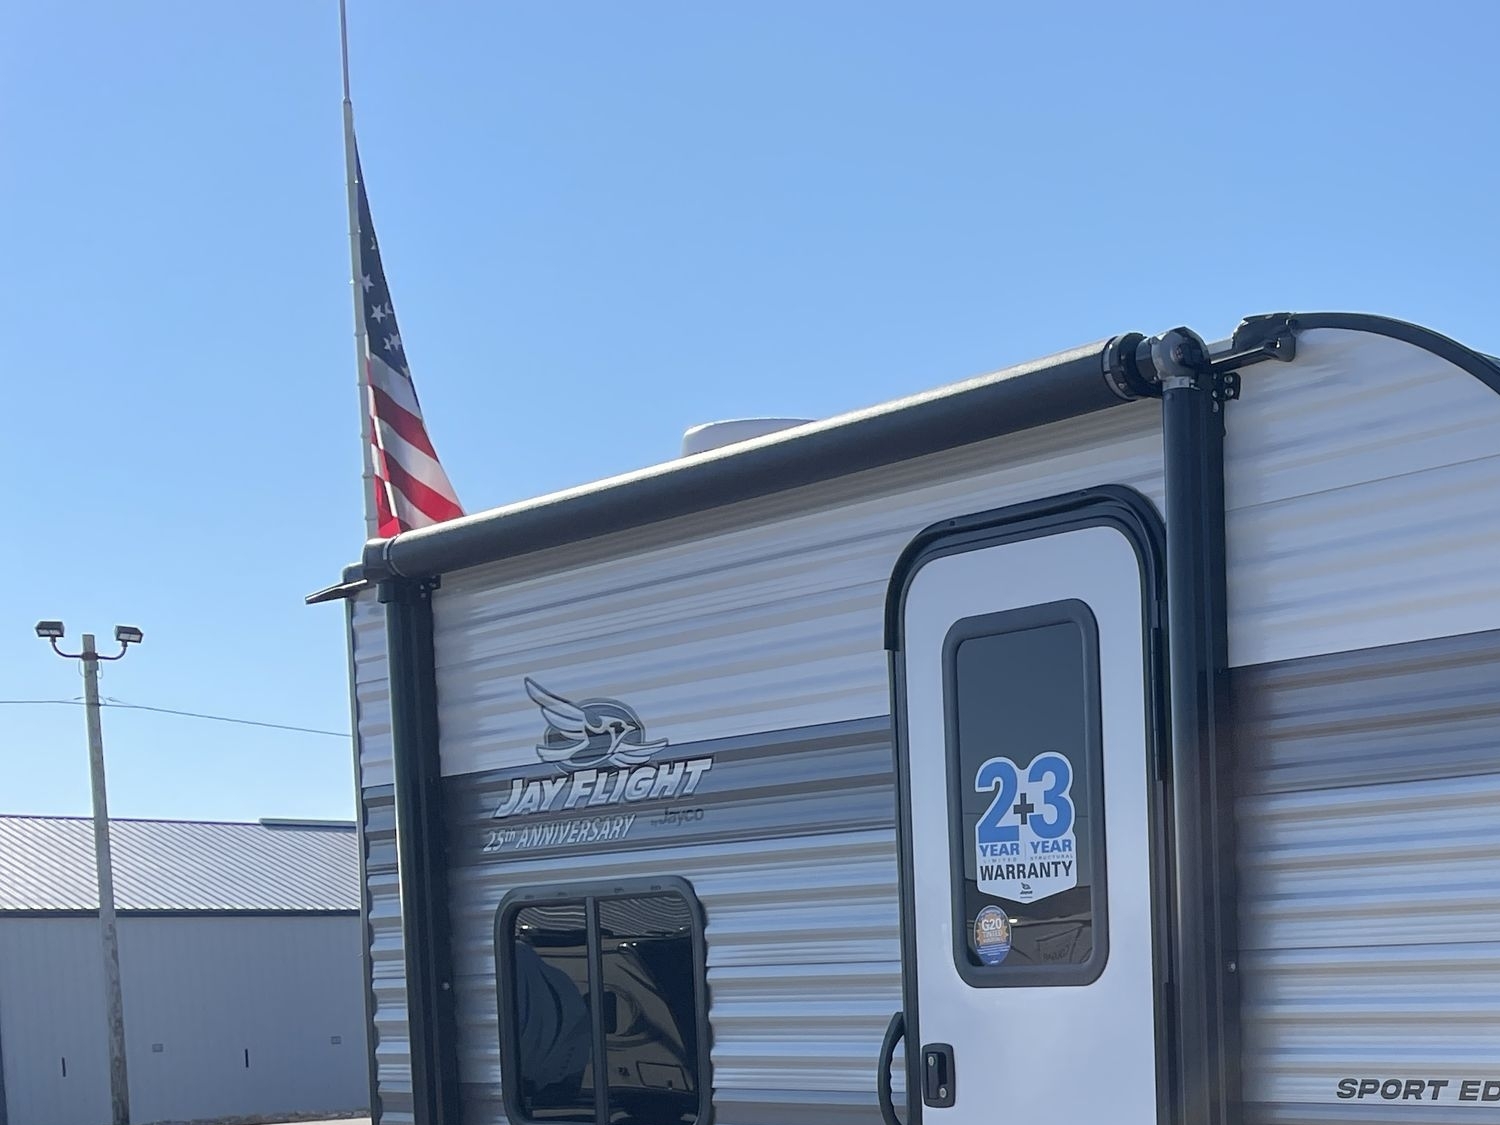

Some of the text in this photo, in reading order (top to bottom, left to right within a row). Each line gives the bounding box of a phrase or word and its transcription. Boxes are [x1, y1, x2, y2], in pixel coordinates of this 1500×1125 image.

[493, 756, 716, 819] JAY FLIGHT
[482, 813, 637, 852] 25th ANNIVERSARY
[979, 838, 1073, 858] YEAR YEAR
[983, 853, 1074, 864] LIMITED STRUCTURAL
[980, 860, 1073, 881] WARRANTY
[981, 918, 1002, 931] G20
[1336, 1078, 1449, 1101] SPORT
